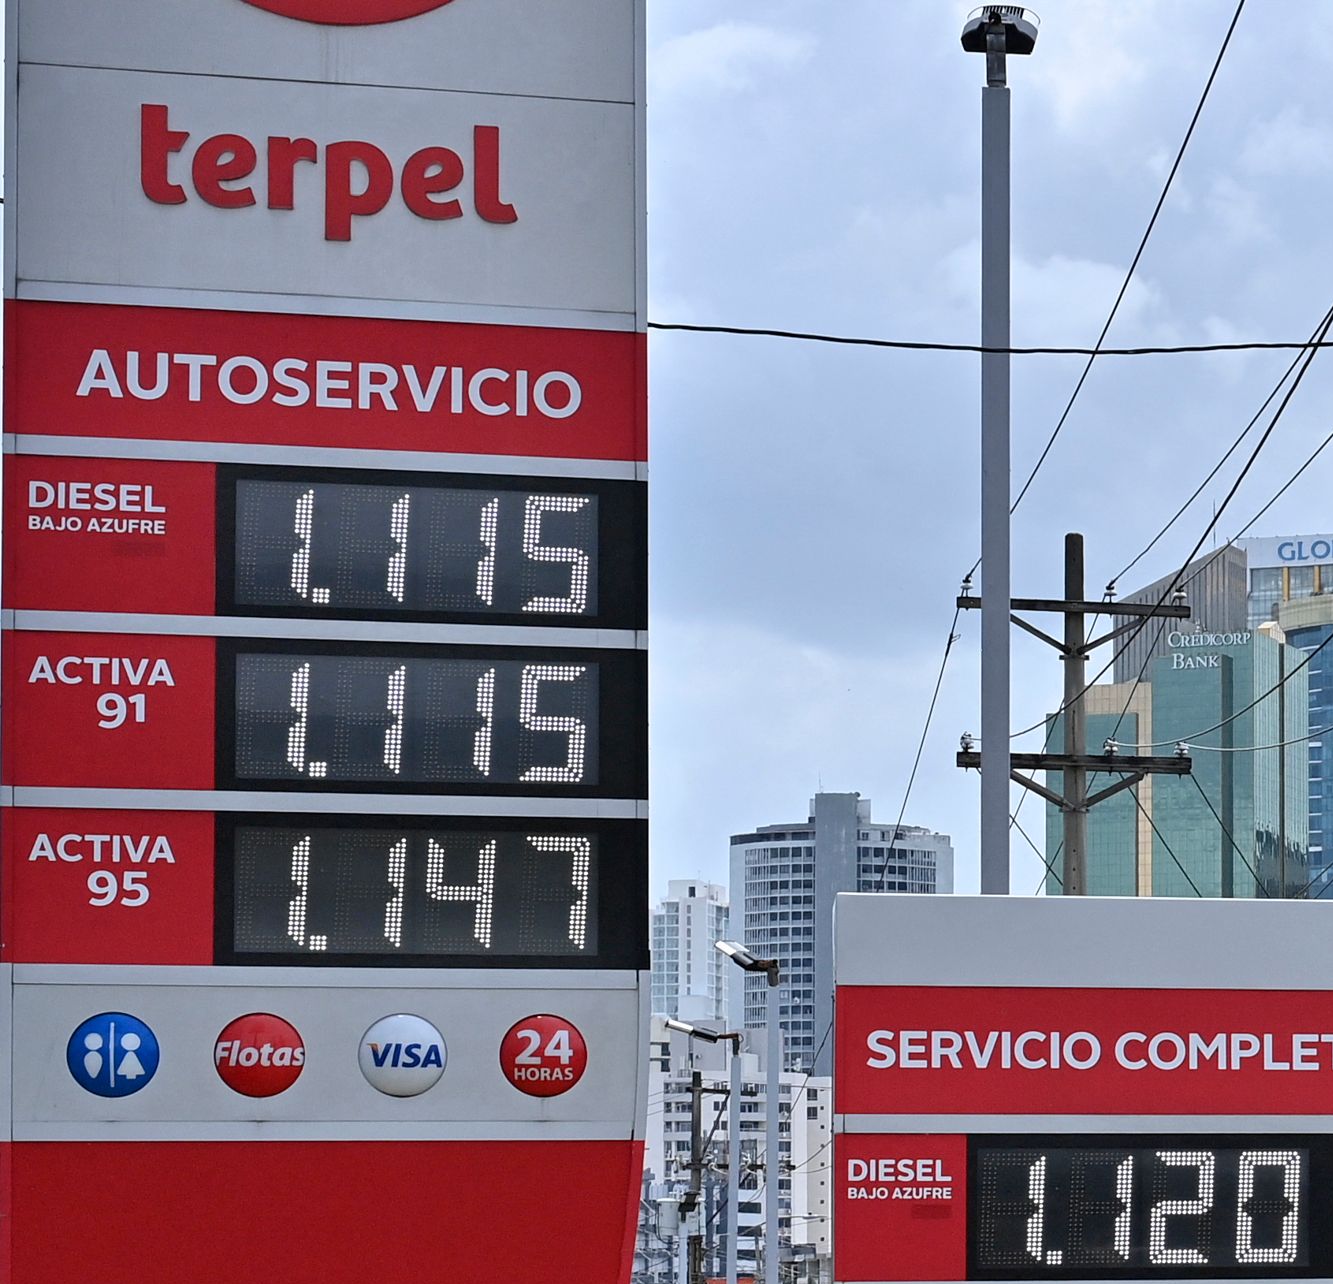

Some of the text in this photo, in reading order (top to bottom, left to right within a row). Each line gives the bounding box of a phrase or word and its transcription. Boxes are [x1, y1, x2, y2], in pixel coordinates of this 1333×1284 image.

[141, 104, 518, 241] terpel
[76, 349, 582, 419] AUTOSERVICIO
[28, 480, 166, 513] DIESEL
[28, 515, 166, 535] BAJO AZUFRE
[290, 487, 591, 613] 1.115
[28, 655, 175, 687] ACTIVA
[1171, 652, 1221, 671] BANK
[96, 692, 146, 729] 91
[287, 662, 587, 783] 1.115
[28, 833, 176, 864] ACTIVA
[87, 870, 150, 907] 95
[287, 836, 591, 951] 1.147
[216, 1039, 306, 1068] Flotas
[368, 1043, 443, 1069] VISA
[515, 1028, 574, 1065] 24
[866, 1029, 1101, 1070] SERVICIO
[513, 1067, 575, 1082] HORAS
[847, 1158, 952, 1182] DIESEL
[847, 1187, 952, 1200] BAJO AZUFRE
[1026, 1151, 1300, 1265] 1.120
